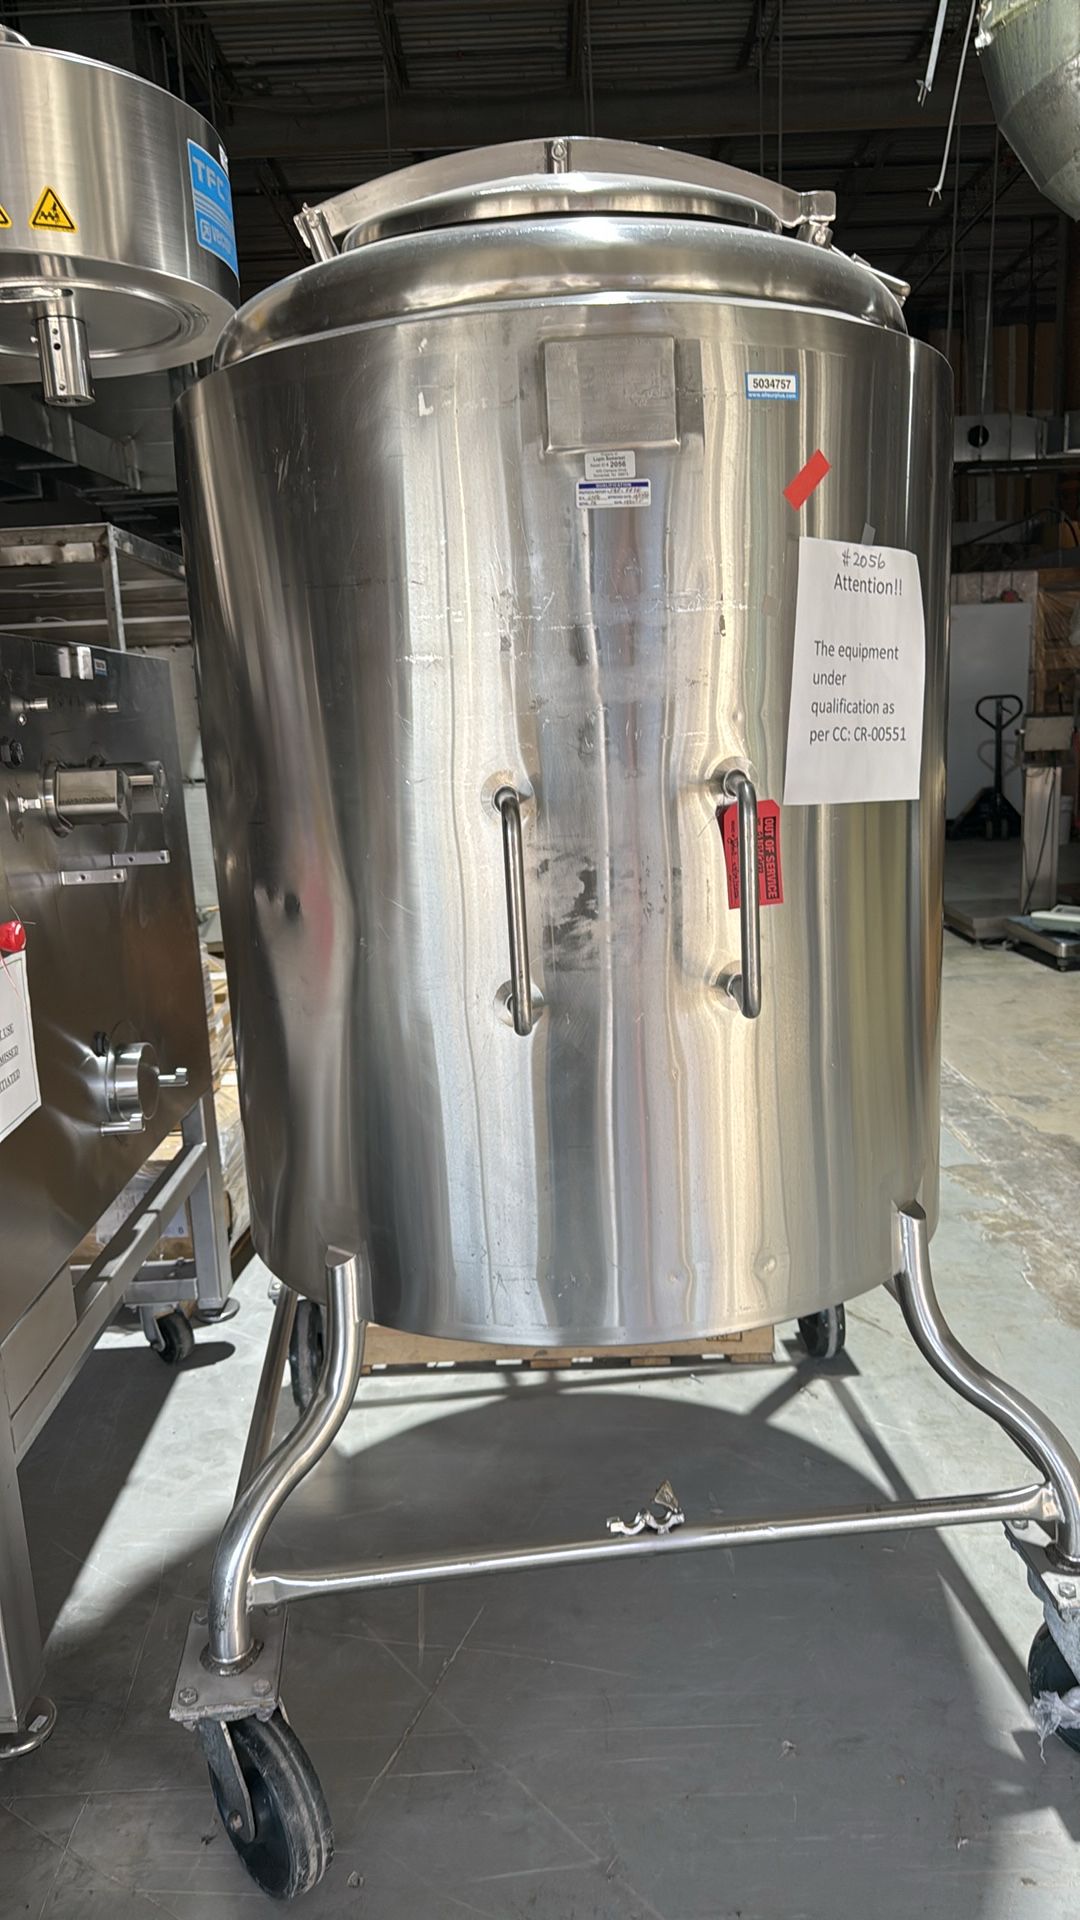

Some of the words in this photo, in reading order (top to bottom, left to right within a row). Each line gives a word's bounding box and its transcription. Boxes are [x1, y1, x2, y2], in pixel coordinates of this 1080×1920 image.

[752, 377, 791, 390] 5034757
[610, 460, 627, 468] 2056
[842, 548, 886, 569] #2056
[834, 573, 902, 596] Attention!!
[814, 640, 835, 657] The
[838, 642, 899, 662] equipment
[813, 669, 847, 685] under
[811, 697, 880, 717] qualification
[882, 702, 895, 715] as
[809, 729, 830, 745] per
[832, 726, 851, 742] CC:
[853, 726, 907, 742] CR-00551
[764, 818, 775, 837] OUT
[765, 838, 775, 853] OF
[766, 855, 778, 899] SERVICE
